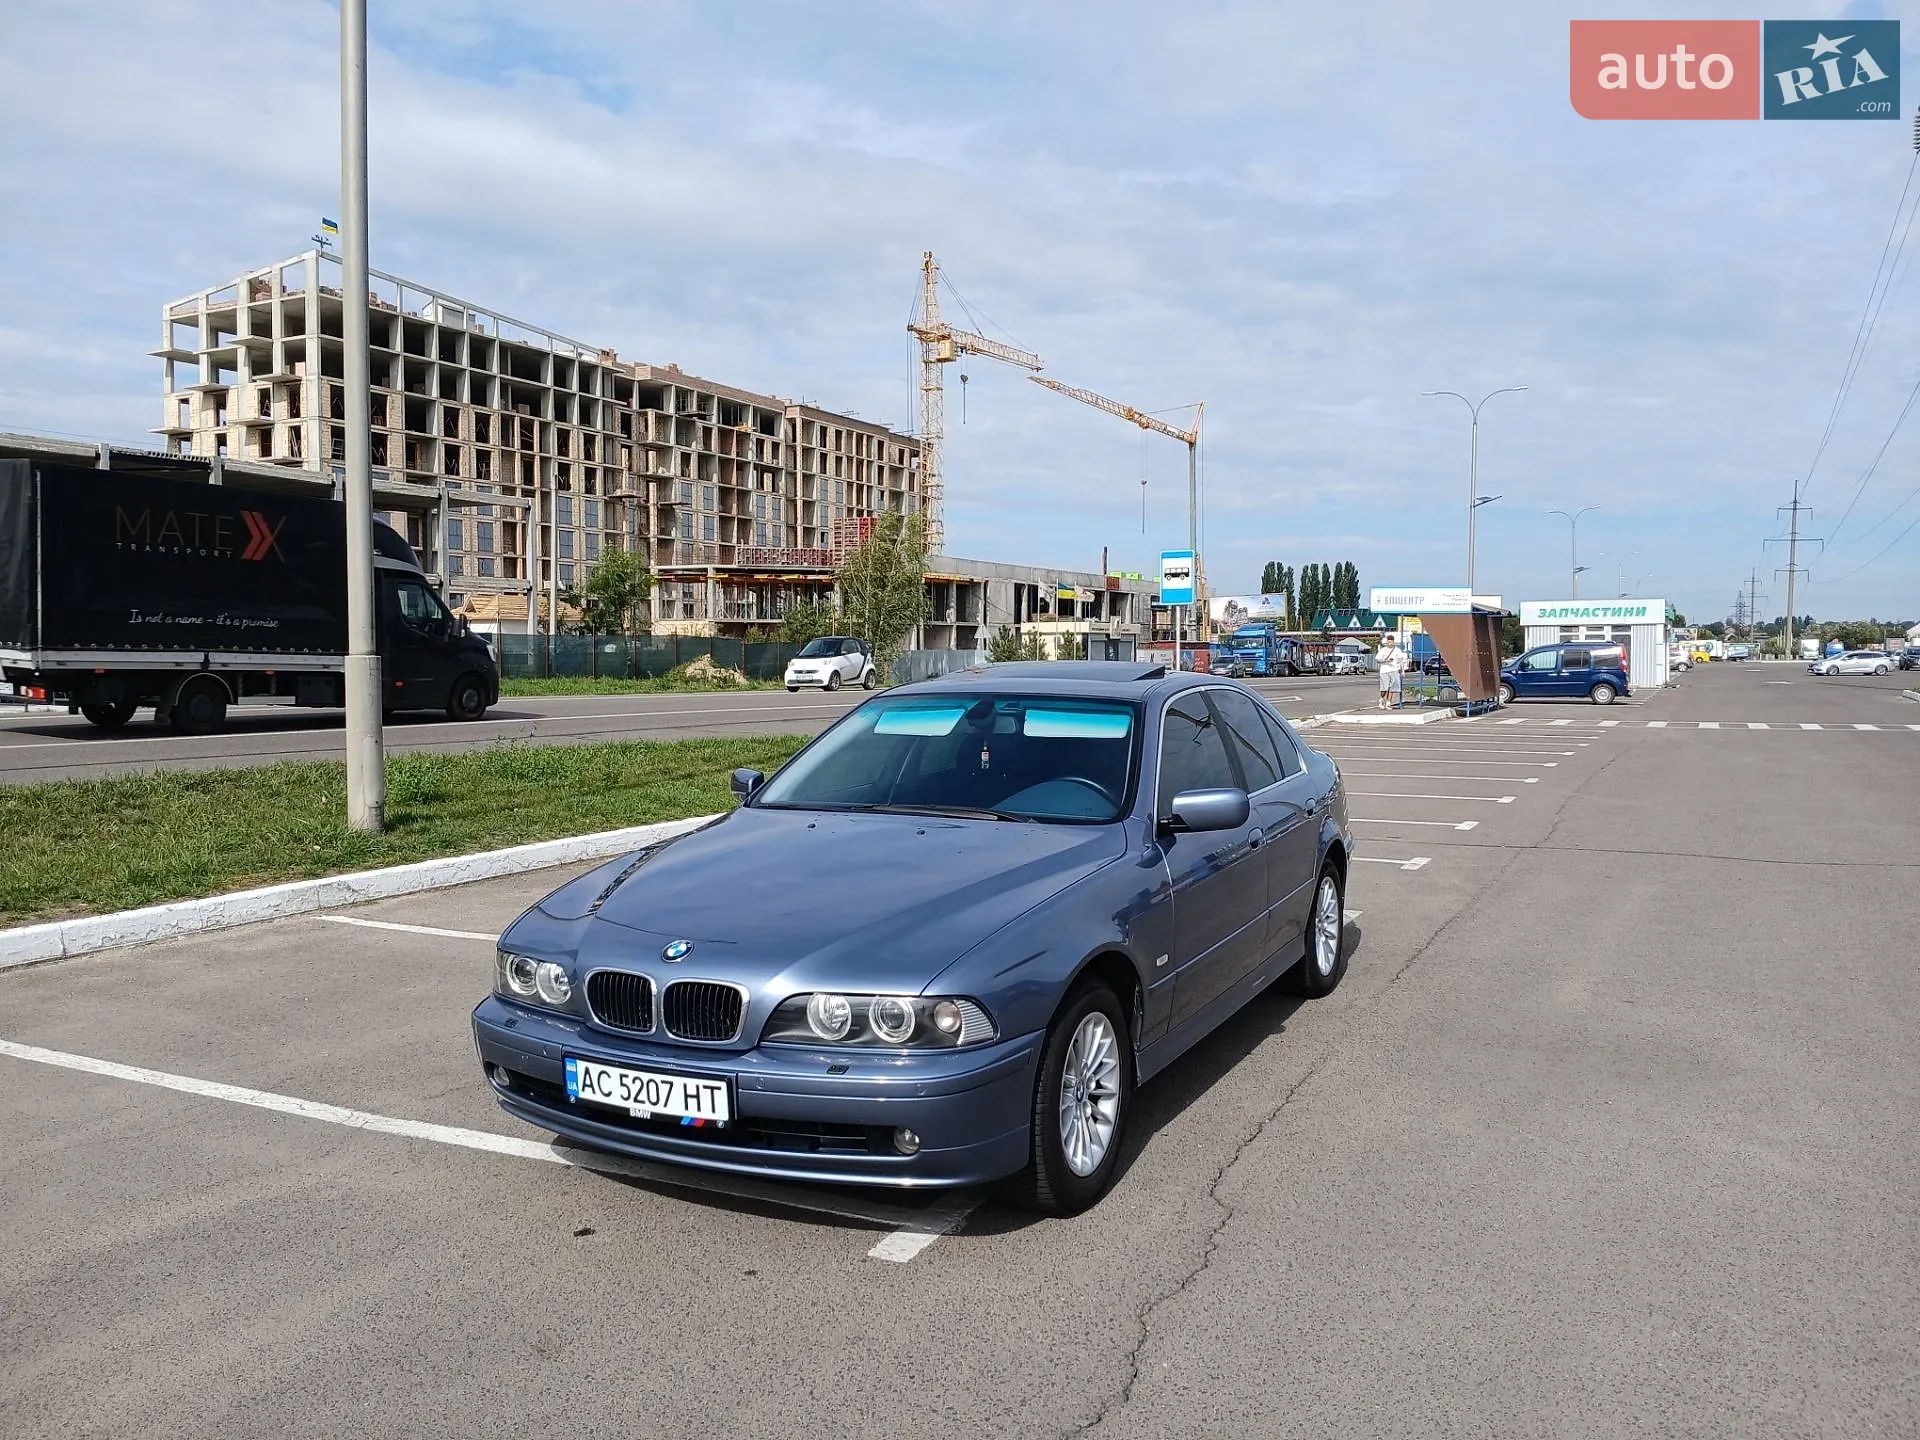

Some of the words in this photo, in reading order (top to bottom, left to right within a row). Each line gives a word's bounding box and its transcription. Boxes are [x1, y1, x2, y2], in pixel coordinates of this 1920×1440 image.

[116, 542, 232, 558] TRANSPORT
[1384, 596, 1425, 606] ЕПІЦЕНТР
[1537, 606, 1647, 618] ЗАПЧАСТИНИ
[128, 609, 142, 623] Is
[145, 612, 163, 623] not
[174, 616, 204, 624] name
[241, 617, 280, 629] promise
[568, 1082, 578, 1092] UA
[581, 1066, 613, 1098] AC
[619, 1073, 674, 1108] 5207
[683, 1082, 722, 1114] HT
[629, 1107, 652, 1120] BMW
